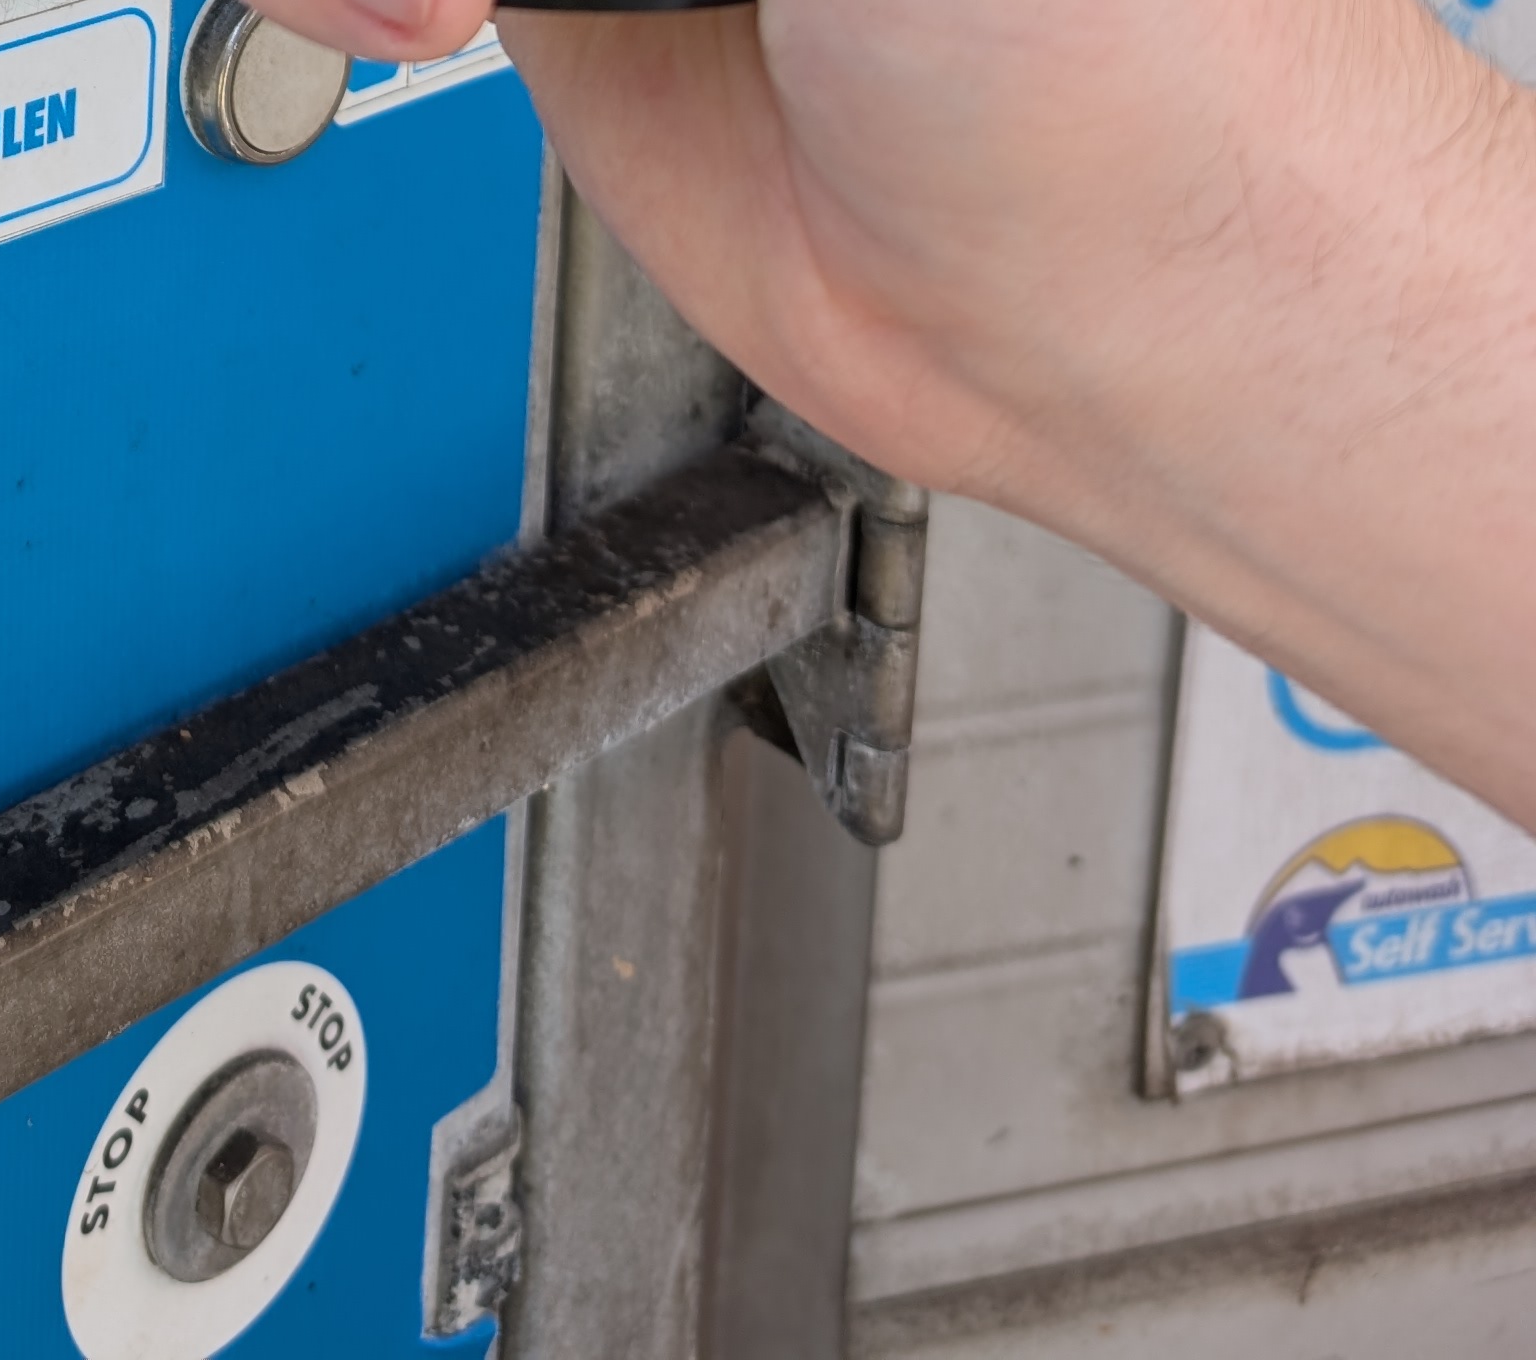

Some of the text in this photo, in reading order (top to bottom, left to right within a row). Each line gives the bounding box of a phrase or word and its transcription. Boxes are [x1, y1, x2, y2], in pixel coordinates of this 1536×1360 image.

[1346, 909, 1442, 976] Self
[291, 983, 354, 1072] STOP
[80, 1088, 151, 1236] STOP
